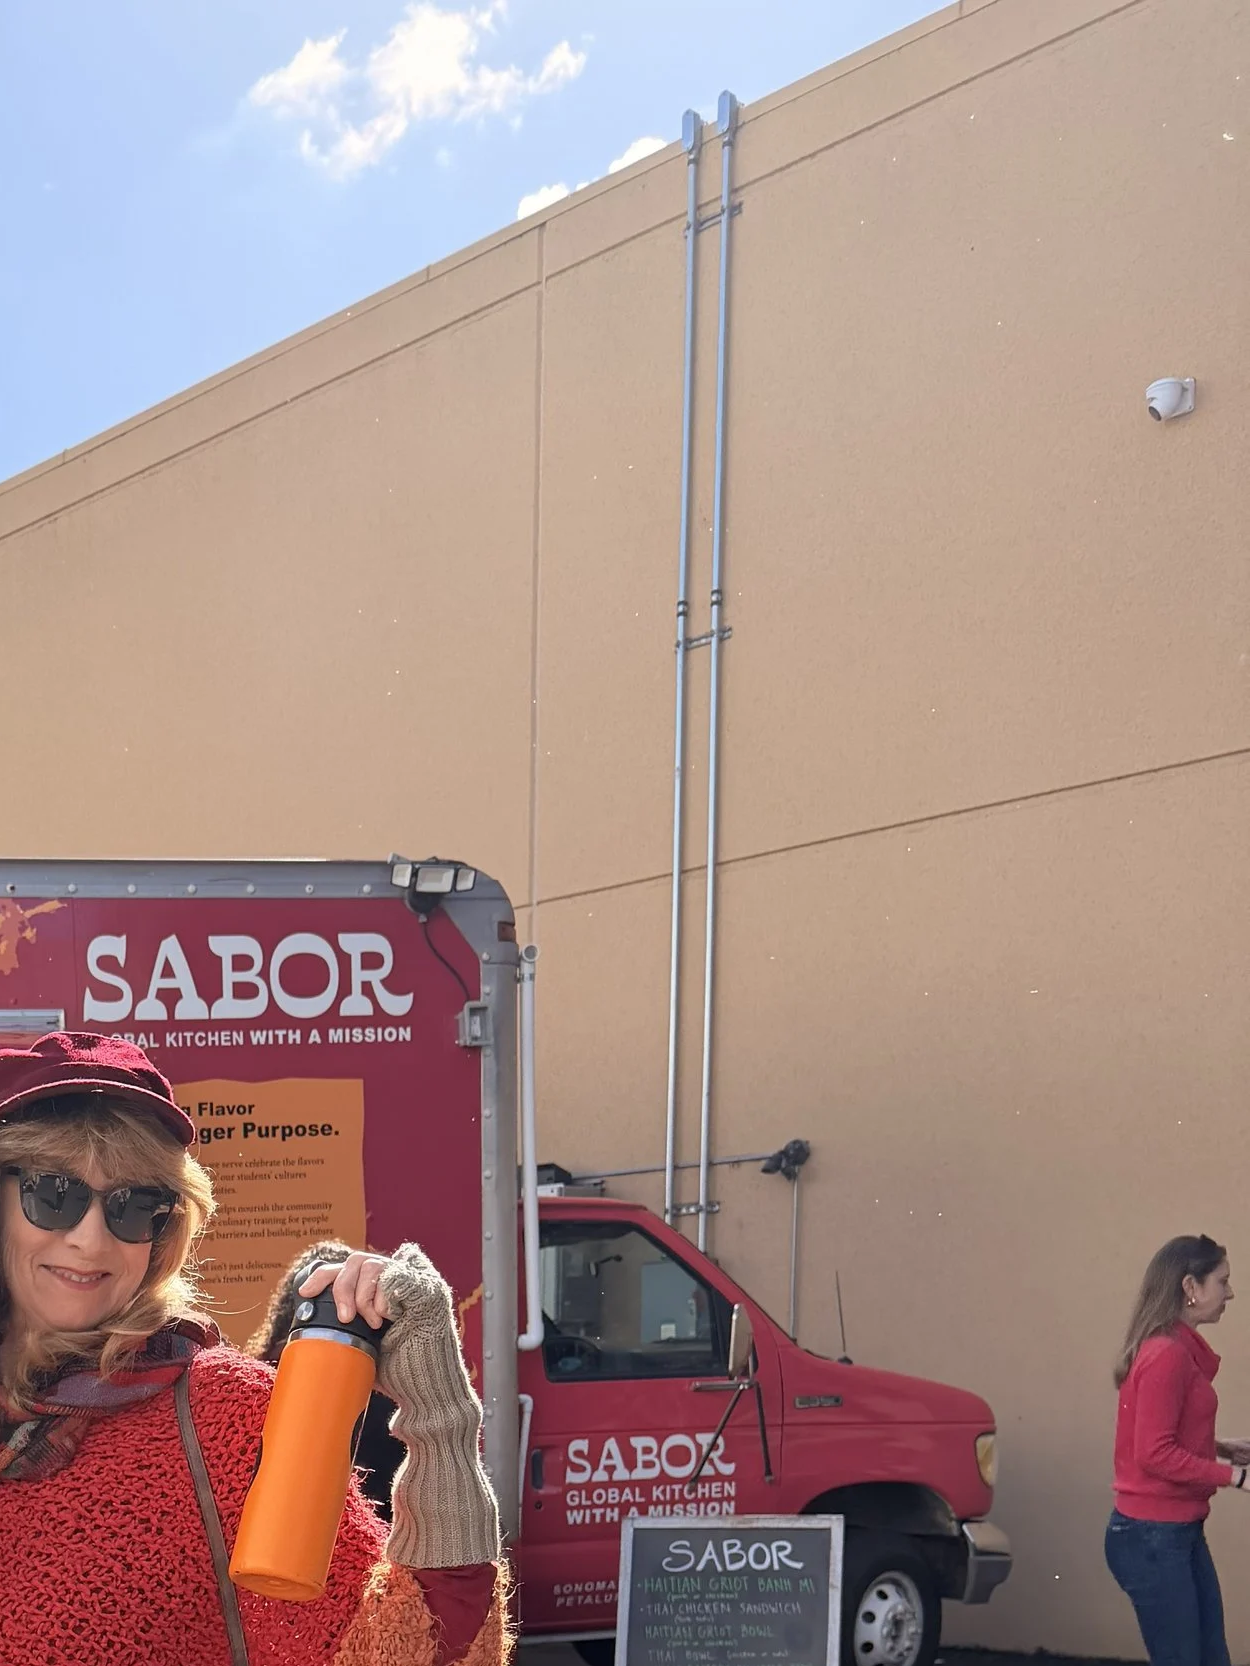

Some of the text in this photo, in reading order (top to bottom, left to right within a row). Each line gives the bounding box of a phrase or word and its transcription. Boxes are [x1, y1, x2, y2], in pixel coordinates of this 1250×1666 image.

[83, 932, 414, 1023] SABOR
[165, 1031, 244, 1047] KITCHEN
[250, 1028, 301, 1045] WITH
[308, 1028, 322, 1044] A
[328, 1026, 412, 1044] MISSION
[197, 1102, 255, 1116] Flavor
[243, 1122, 340, 1142] Purpose.
[245, 1157, 281, 1168] celebrate
[283, 1157, 295, 1167] the
[297, 1156, 325, 1166] flavors
[275, 1170, 307, 1180] cultures
[238, 1202, 270, 1213] nourish
[271, 1203, 285, 1212] the
[286, 1201, 332, 1212] community
[218, 1216, 251, 1227] culinary
[254, 1215, 286, 1226] training
[288, 1215, 300, 1224] for
[302, 1214, 329, 1225] people
[216, 1229, 248, 1239] barriers
[250, 1227, 265, 1238] and
[267, 1227, 301, 1239] building
[309, 1226, 334, 1236] future
[223, 1273, 243, 1284] fresh
[565, 1432, 736, 1485] SABOR
[566, 1481, 736, 1506] GLOBAL KITCHEN
[566, 1500, 736, 1525] WITH A MISSION
[661, 1538, 804, 1573] SABOR
[553, 1580, 616, 1596] SONOMA
[644, 1575, 816, 1595] HAITIAN GRIOT BANH MI
[556, 1592, 618, 1607] PETALU
[646, 1601, 802, 1616] THAI CHICKEN SANDWICH
